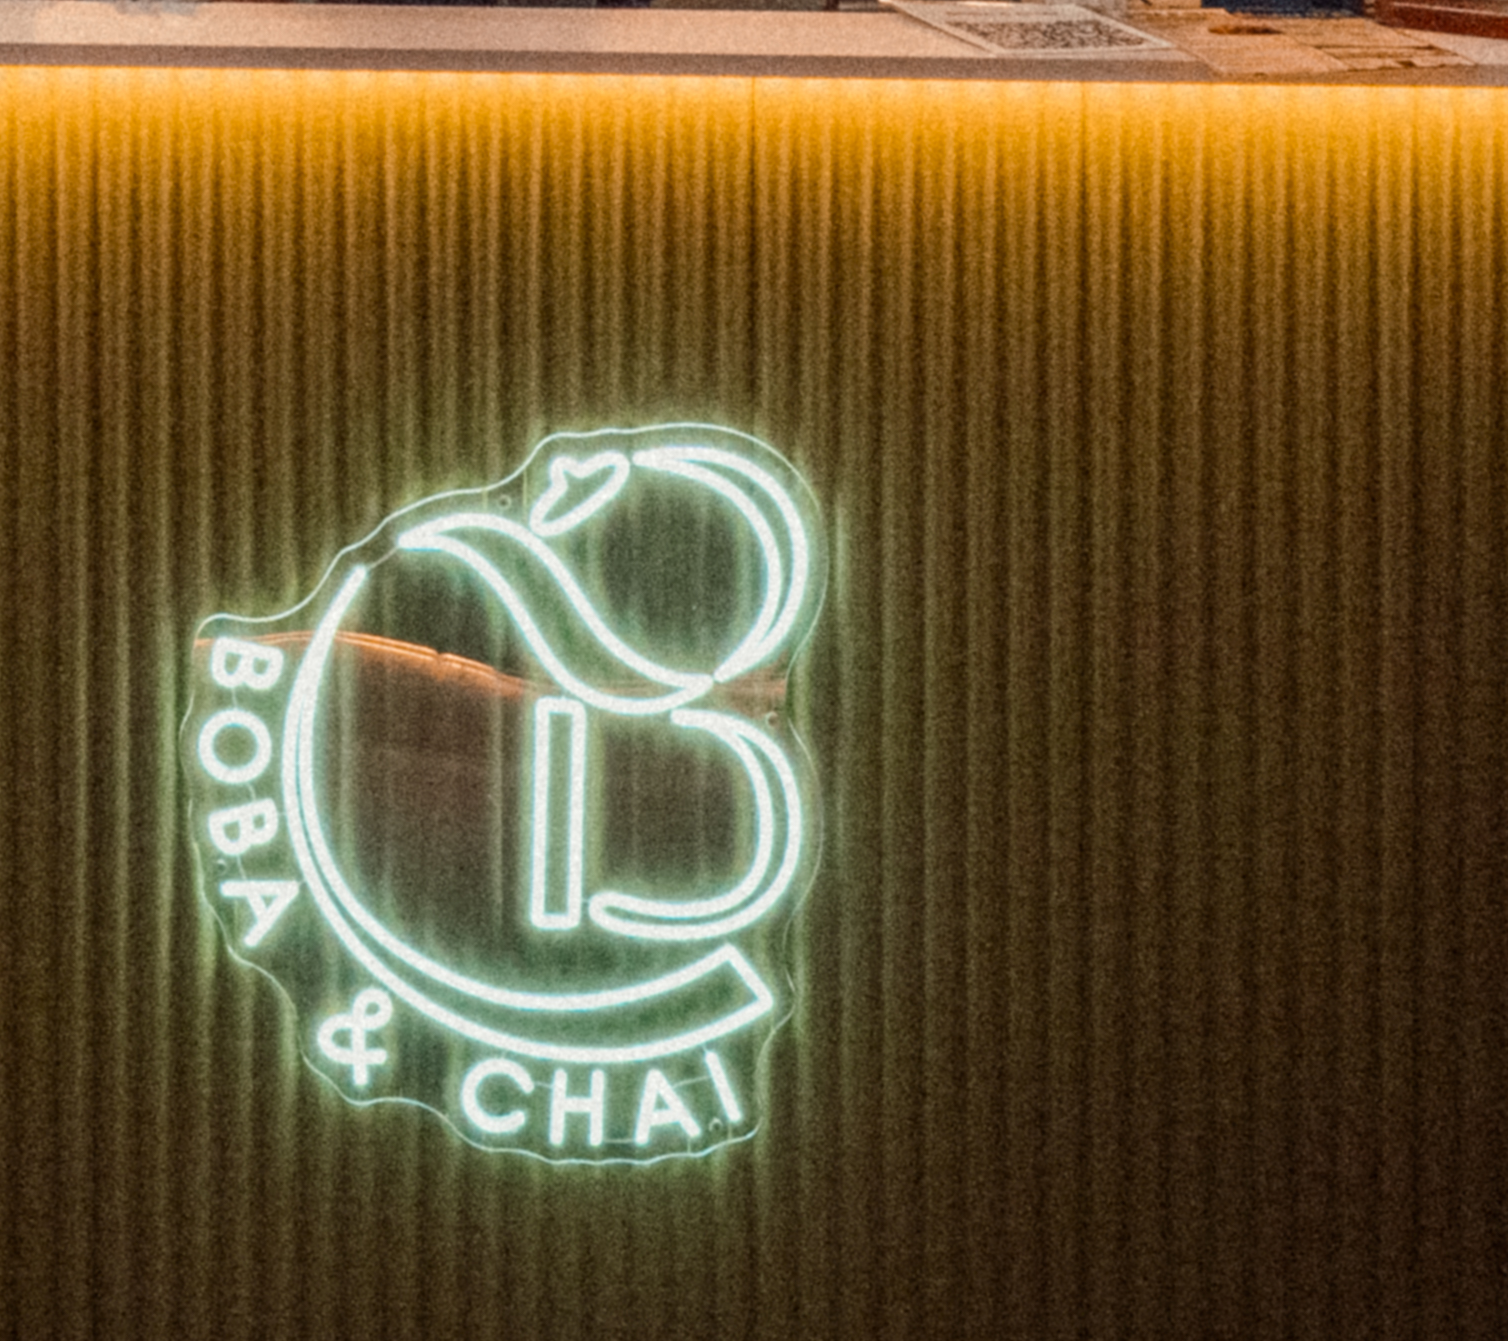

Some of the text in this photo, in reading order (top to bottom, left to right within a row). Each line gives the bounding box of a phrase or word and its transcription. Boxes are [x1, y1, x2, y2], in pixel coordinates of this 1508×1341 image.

[197, 636, 299, 948] BOBA
[317, 988, 394, 1086] &
[461, 1052, 743, 1146] CHAI
